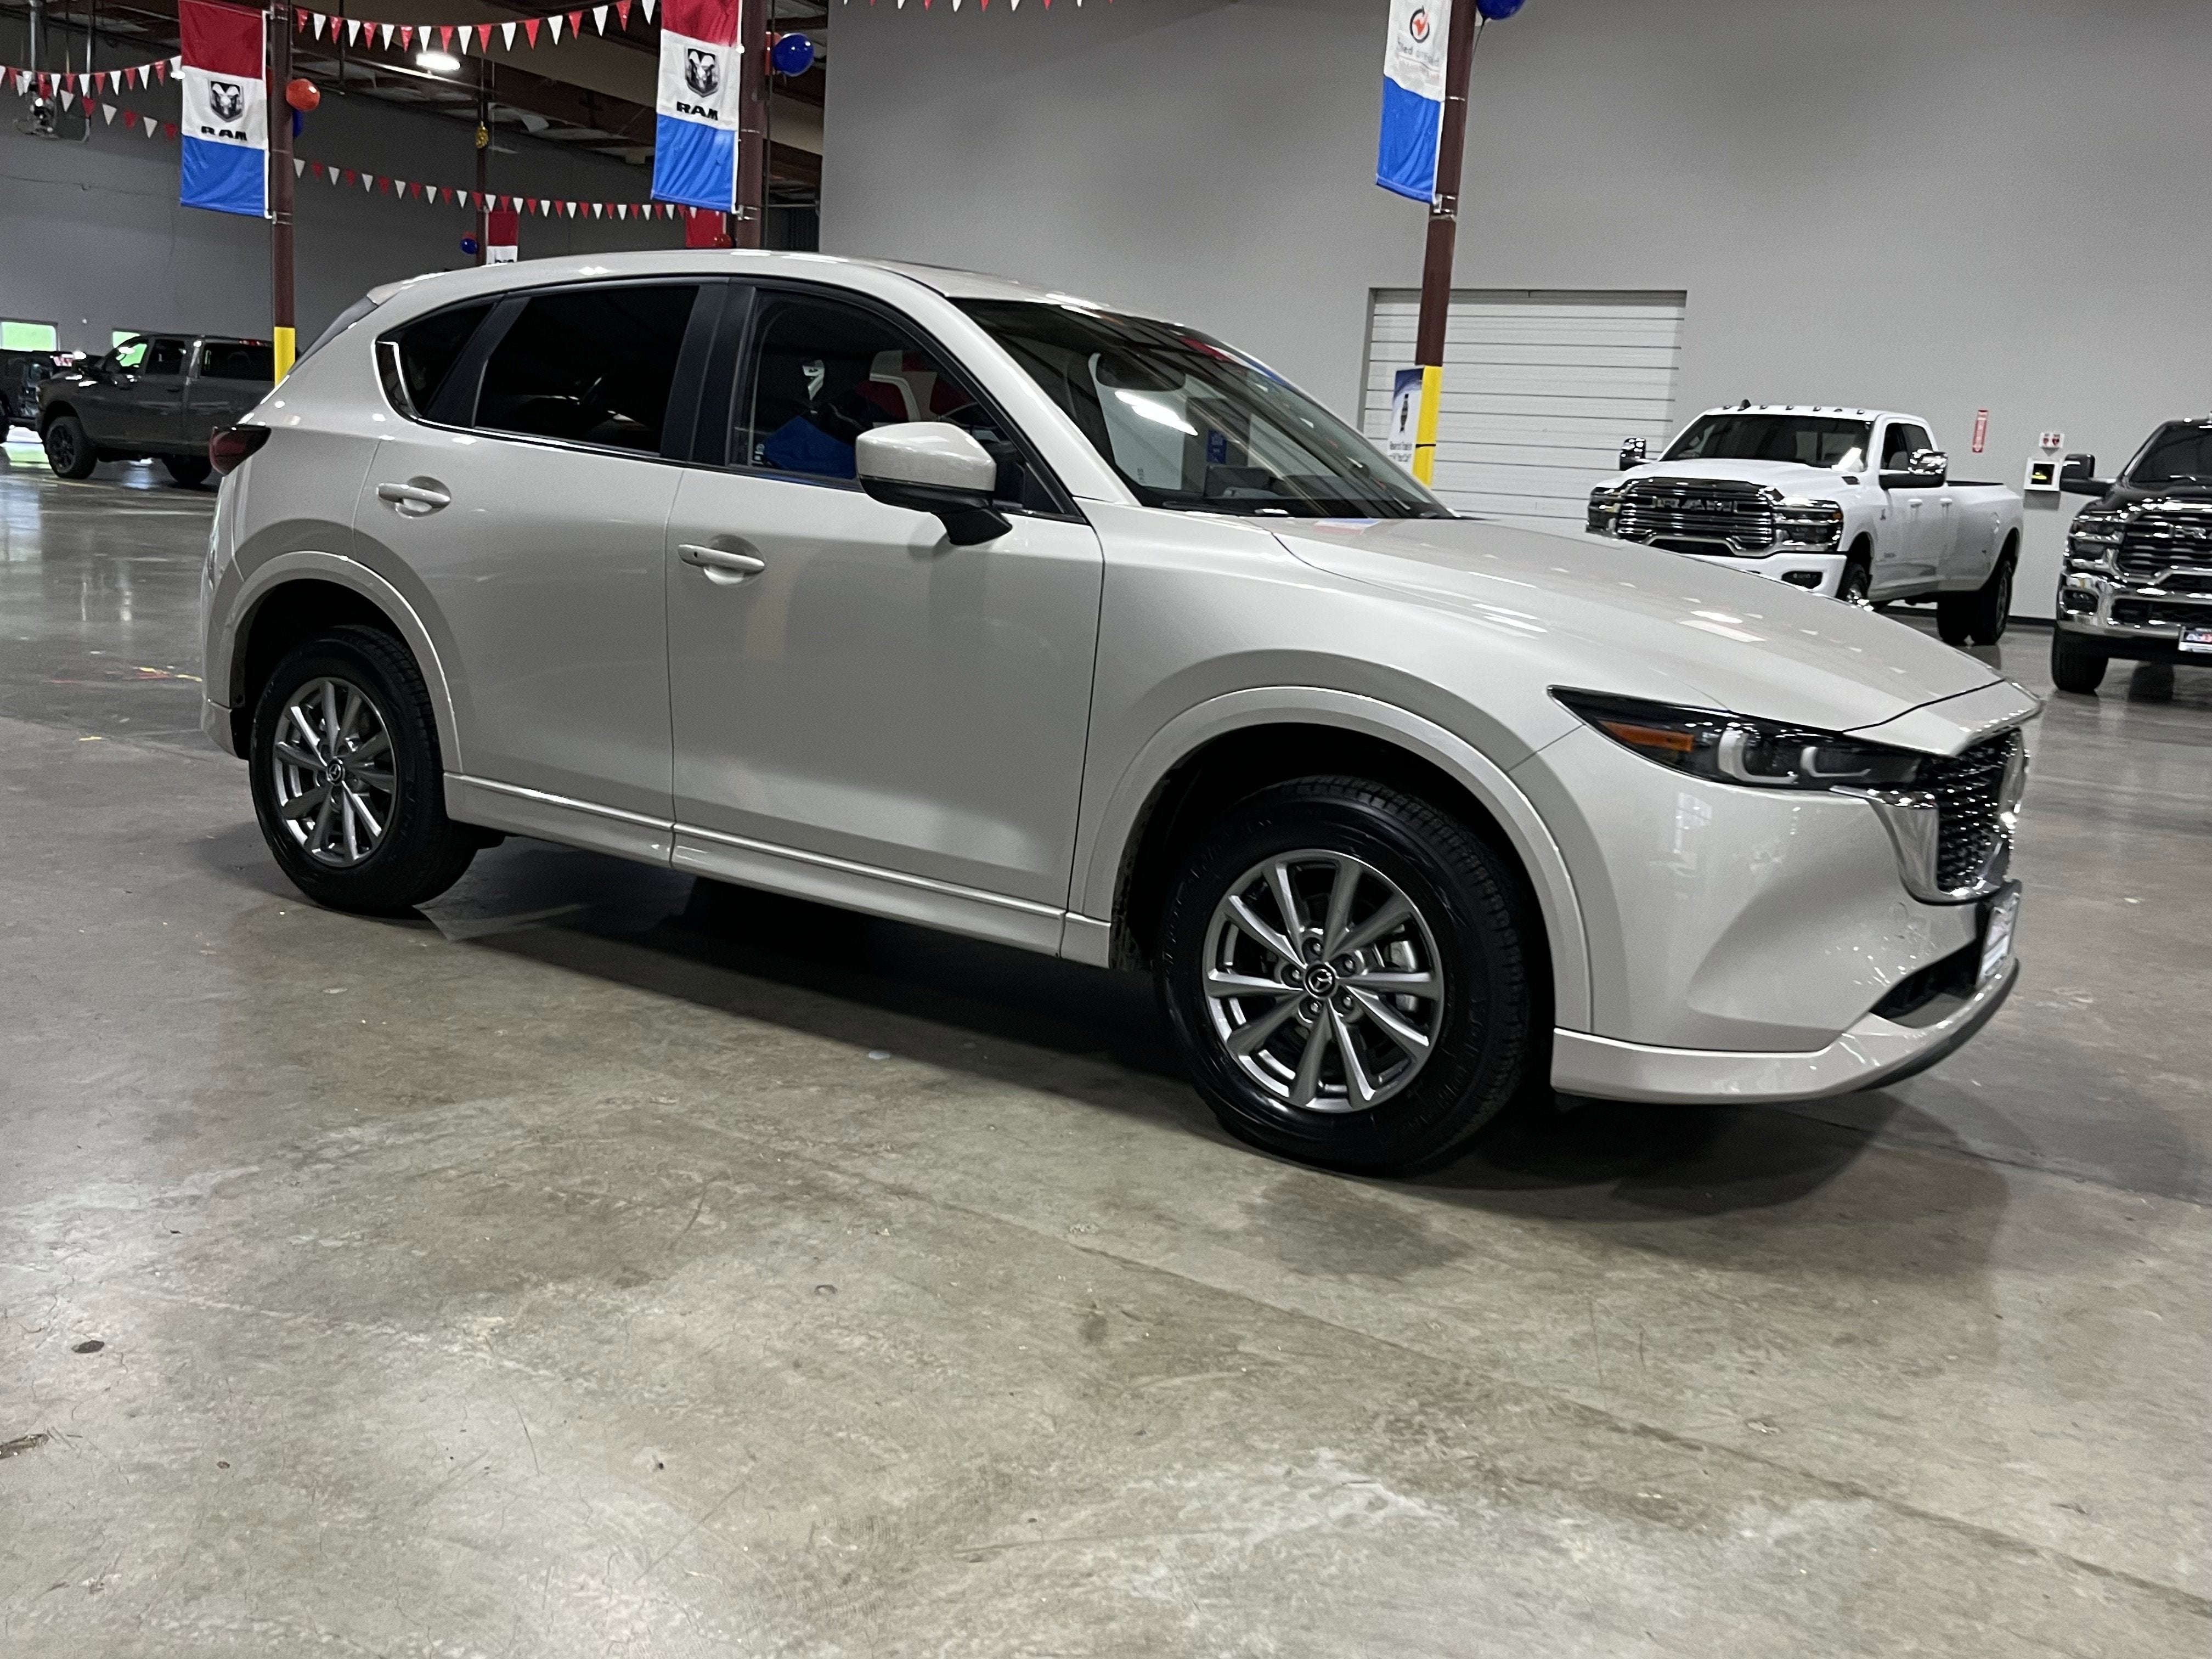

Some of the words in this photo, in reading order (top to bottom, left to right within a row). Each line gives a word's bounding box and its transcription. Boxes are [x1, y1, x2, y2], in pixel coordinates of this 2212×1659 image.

[676, 101, 718, 121] RAM
[201, 126, 247, 141] RAM
[1657, 498, 1732, 512] RAM
